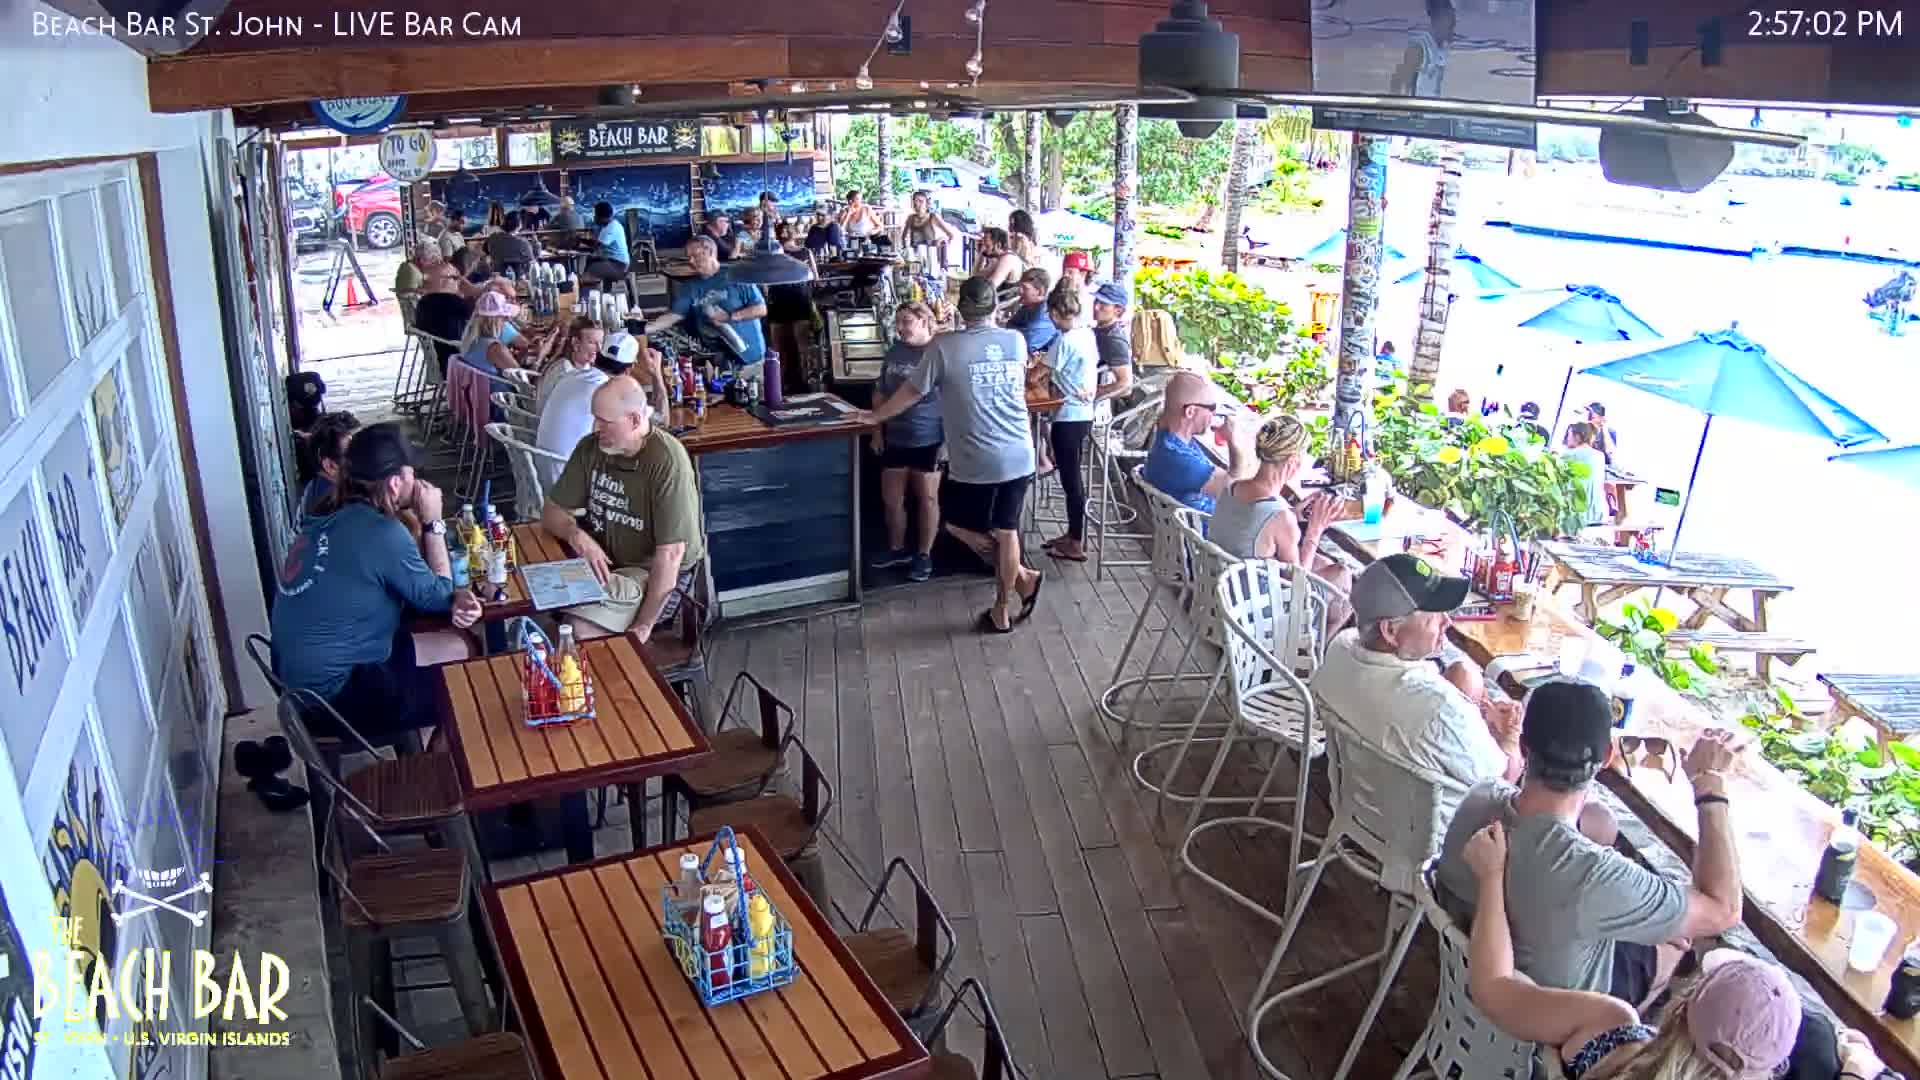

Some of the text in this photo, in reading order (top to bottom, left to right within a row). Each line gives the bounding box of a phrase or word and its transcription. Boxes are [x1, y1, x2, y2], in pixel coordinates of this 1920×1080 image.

[387, 132, 426, 155] TO GO
[588, 126, 669, 148] BEACH BAR
